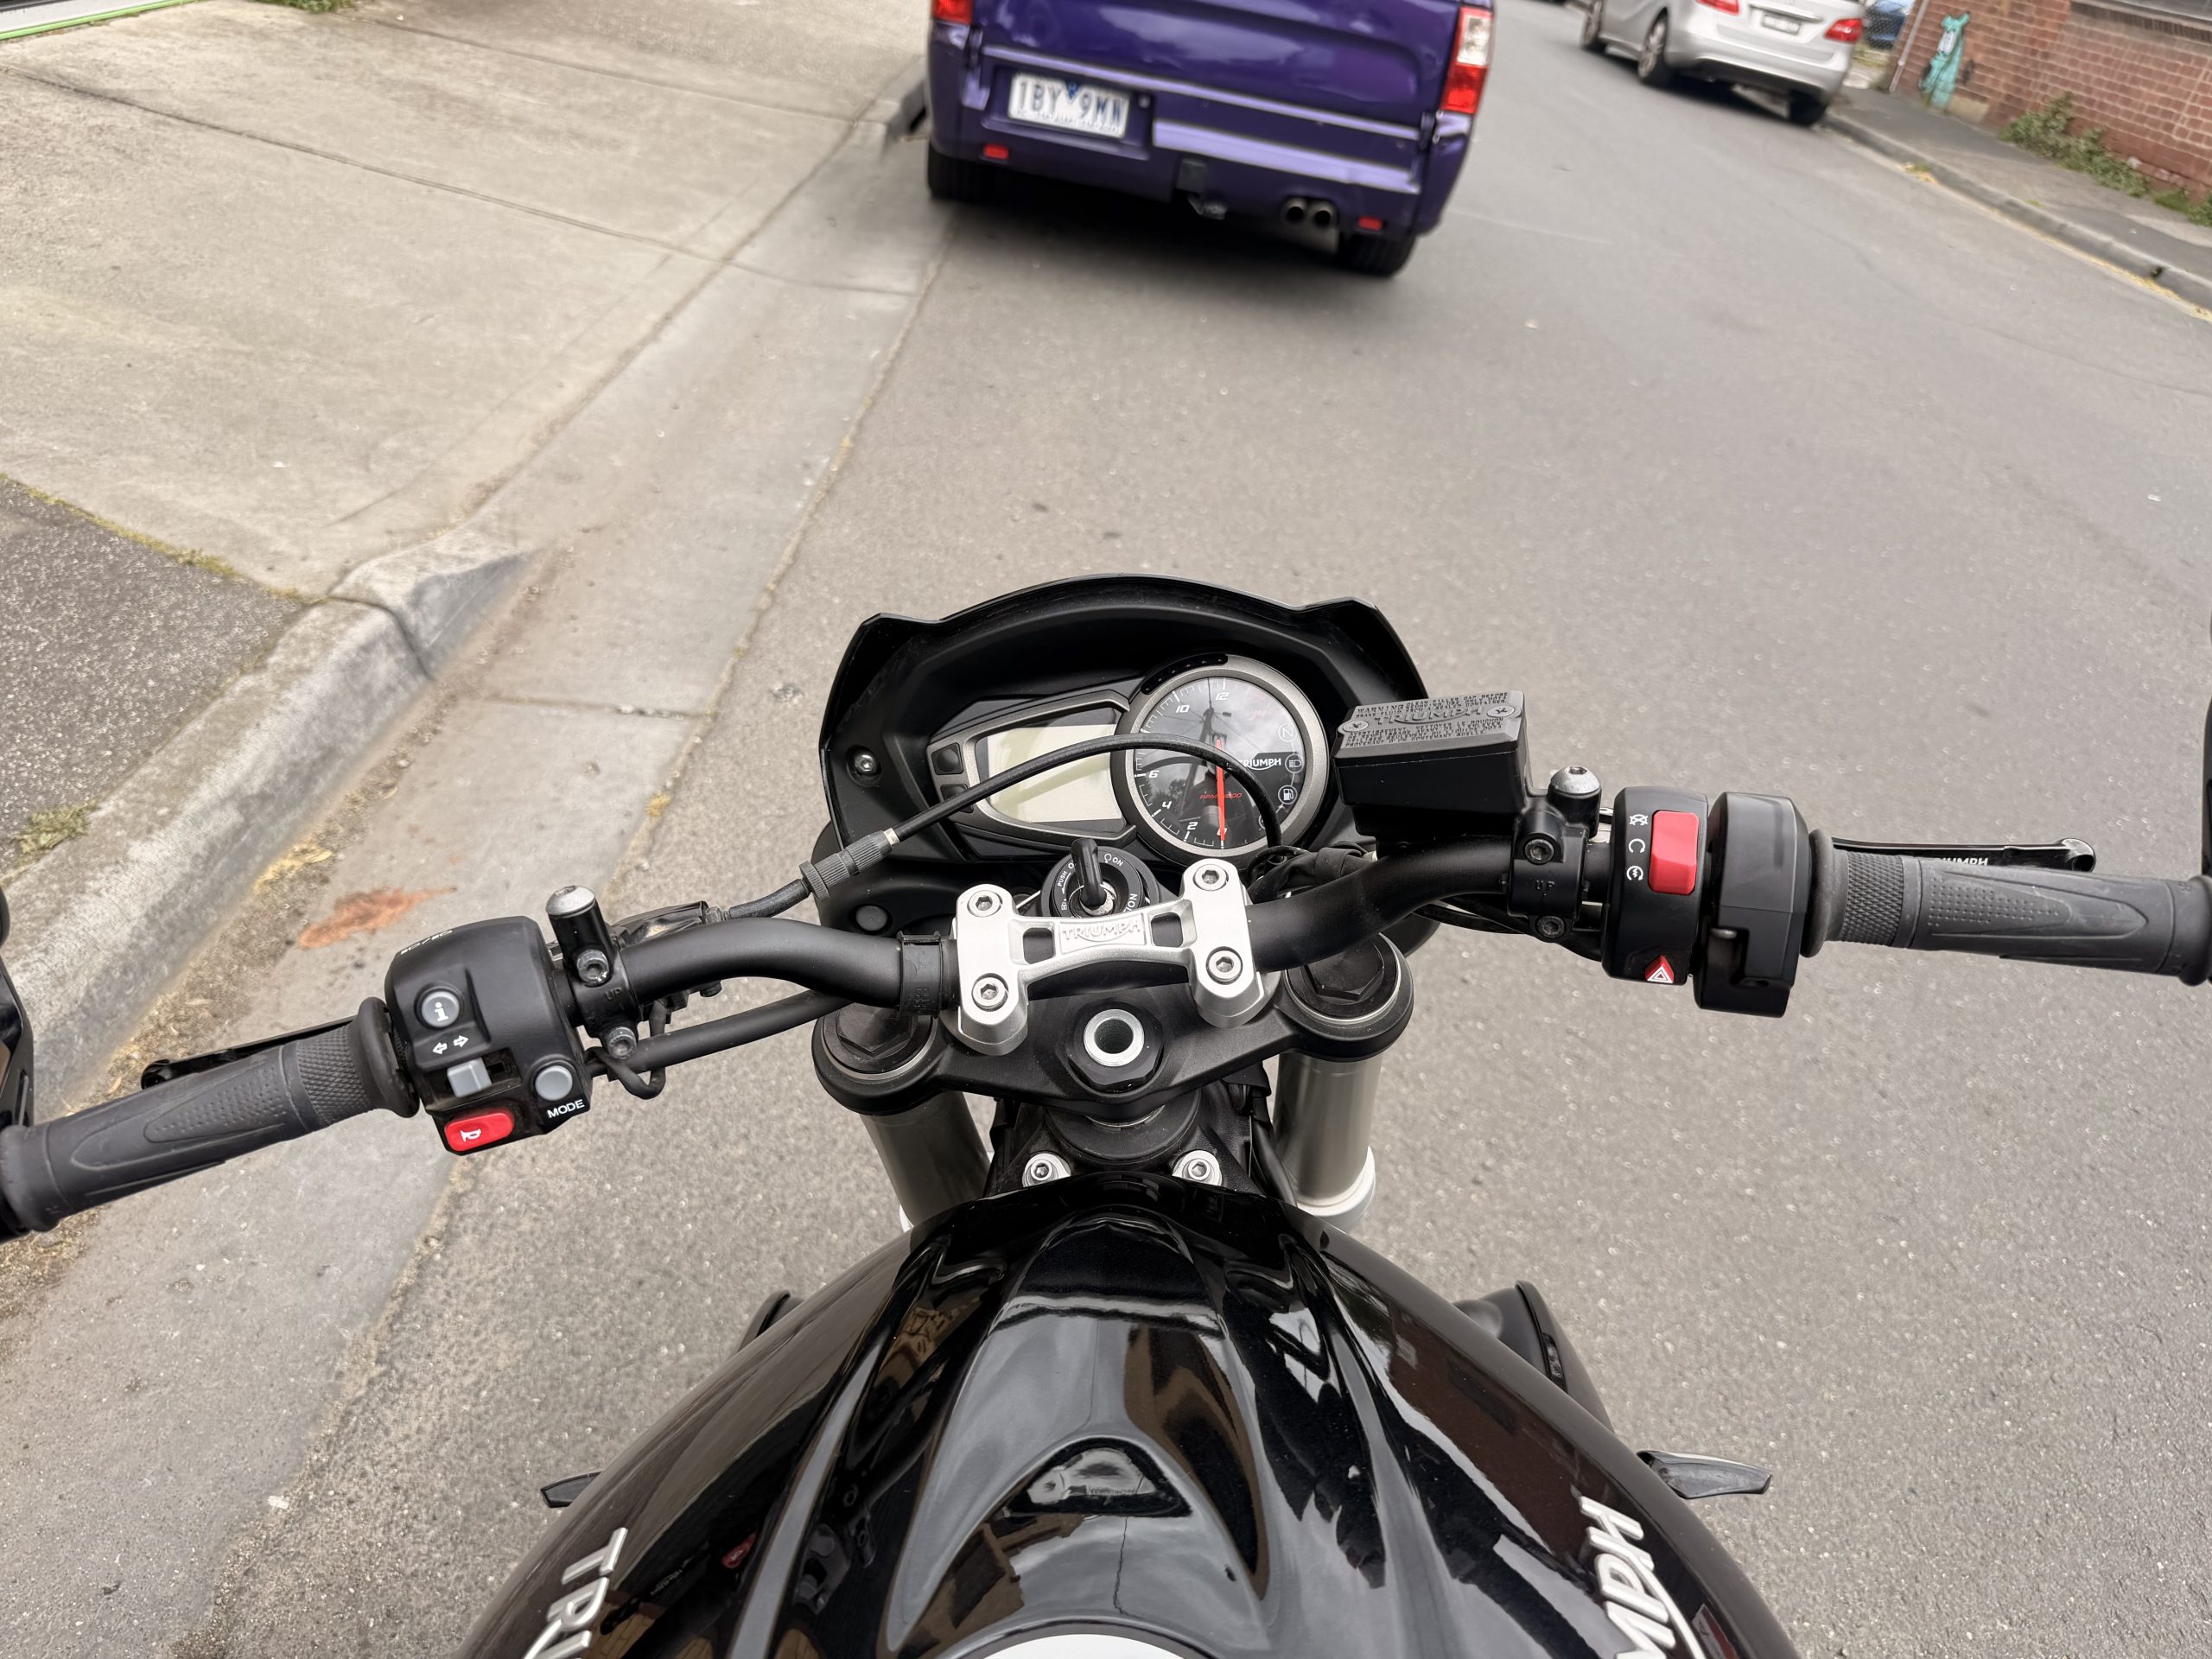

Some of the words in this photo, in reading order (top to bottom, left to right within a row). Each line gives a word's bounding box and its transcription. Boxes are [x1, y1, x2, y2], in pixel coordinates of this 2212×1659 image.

[1216, 692, 1230, 701] 12
[1176, 704, 1190, 713] 10
[1374, 707, 1481, 724] TRIUMPH
[1186, 822, 1198, 830] 2
[1112, 857, 1123, 867] ON
[1057, 870, 1068, 887] PUSH
[1062, 920, 1141, 943] TRIUMPH
[547, 1098, 586, 1119] MODE
